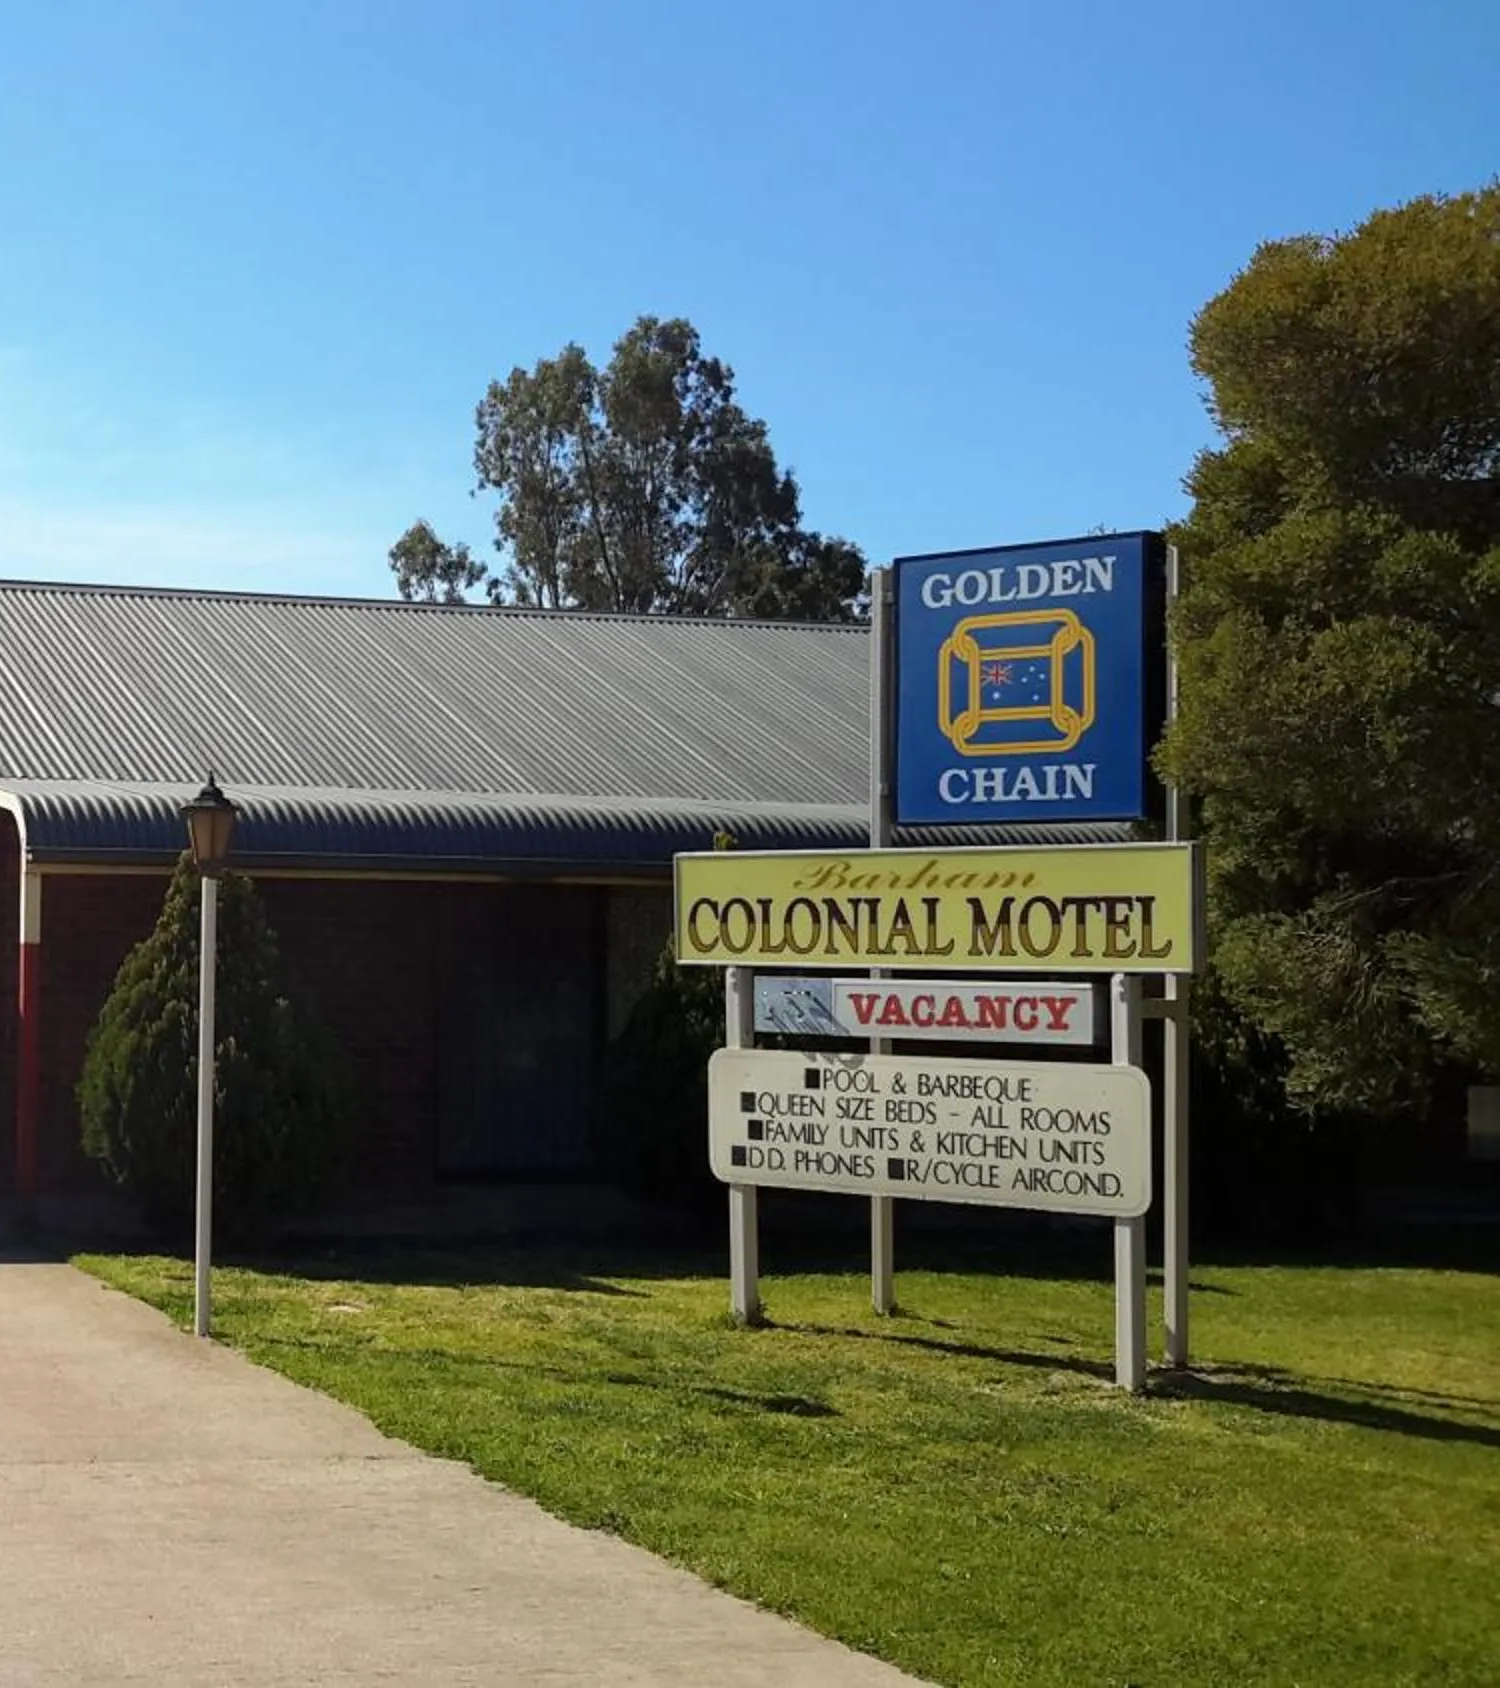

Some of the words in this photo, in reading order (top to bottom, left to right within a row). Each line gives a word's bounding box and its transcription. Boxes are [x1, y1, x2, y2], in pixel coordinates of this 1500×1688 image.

[921, 555, 1117, 609] GOLDEN
[938, 763, 1097, 804] CHAIN
[793, 859, 1036, 891] Barham
[687, 897, 955, 956] COLONIAL
[966, 895, 1173, 959] MOTEL
[847, 992, 1077, 1032] VACANCY
[823, 1069, 881, 1094] POOL
[891, 1071, 907, 1095] &
[917, 1073, 1033, 1105] BARBEQUE
[757, 1091, 826, 1119] QUEEN
[835, 1096, 875, 1121] SIZE
[885, 1100, 937, 1125] BEDS
[970, 1105, 1009, 1129] ALL
[1020, 1107, 1112, 1137] ROOMS
[764, 1119, 830, 1146] FAMILY
[840, 1125, 900, 1151] UNITS
[909, 1130, 926, 1153] &
[936, 1131, 1028, 1161] KITCHEN
[1039, 1137, 1106, 1167] UNITS
[795, 1150, 875, 1178] PHONES
[906, 1158, 1001, 1189] R/CYCLE
[1011, 1167, 1125, 1199] AIRCOND.
